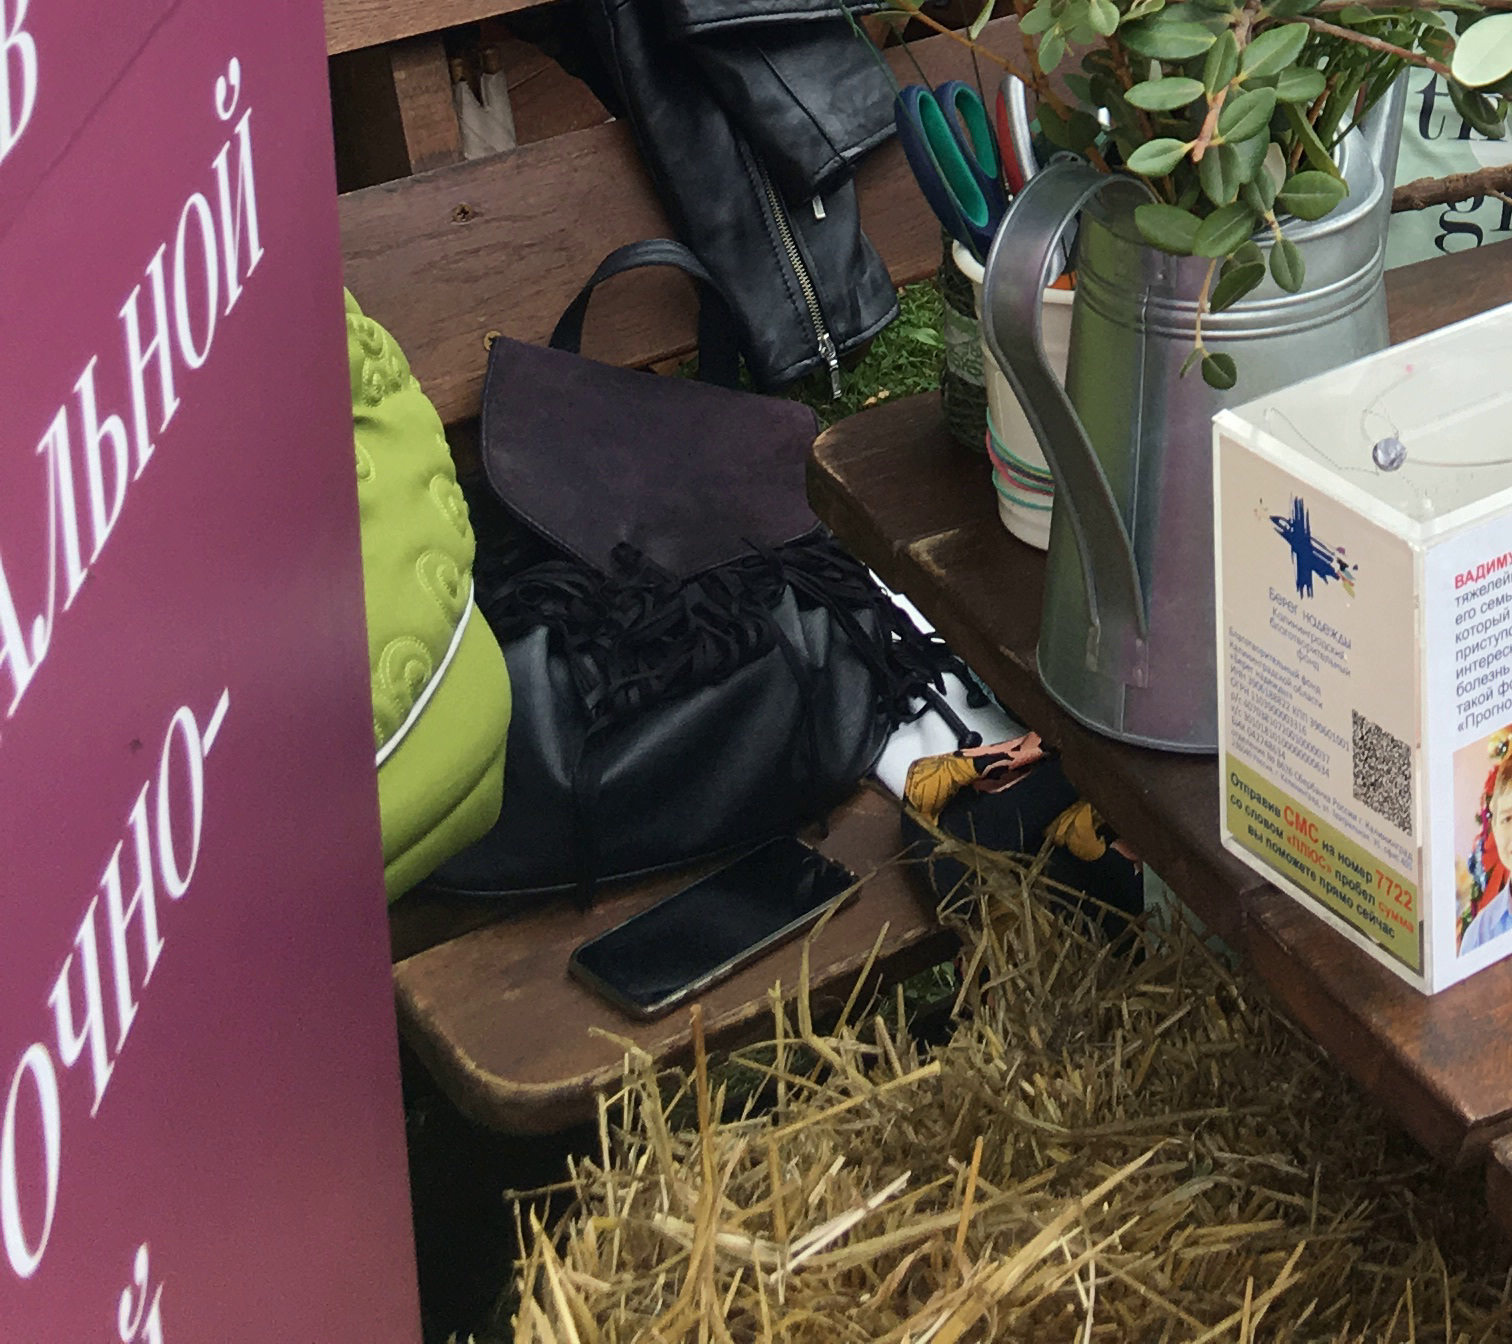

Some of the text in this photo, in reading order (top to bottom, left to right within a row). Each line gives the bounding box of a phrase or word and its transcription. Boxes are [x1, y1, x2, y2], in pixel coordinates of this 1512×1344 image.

[1455, 607, 1476, 626] его
[1455, 606, 1510, 644] который
[1456, 665, 1511, 697] болезнь
[1456, 686, 1494, 715] такой
[1230, 772, 1412, 911] Отправив СМС на номер 7722
[1230, 794, 1413, 933] со словом «ПЛЮС» пробел сумма
[1248, 825, 1395, 939] вы поможете прямо сейчас
